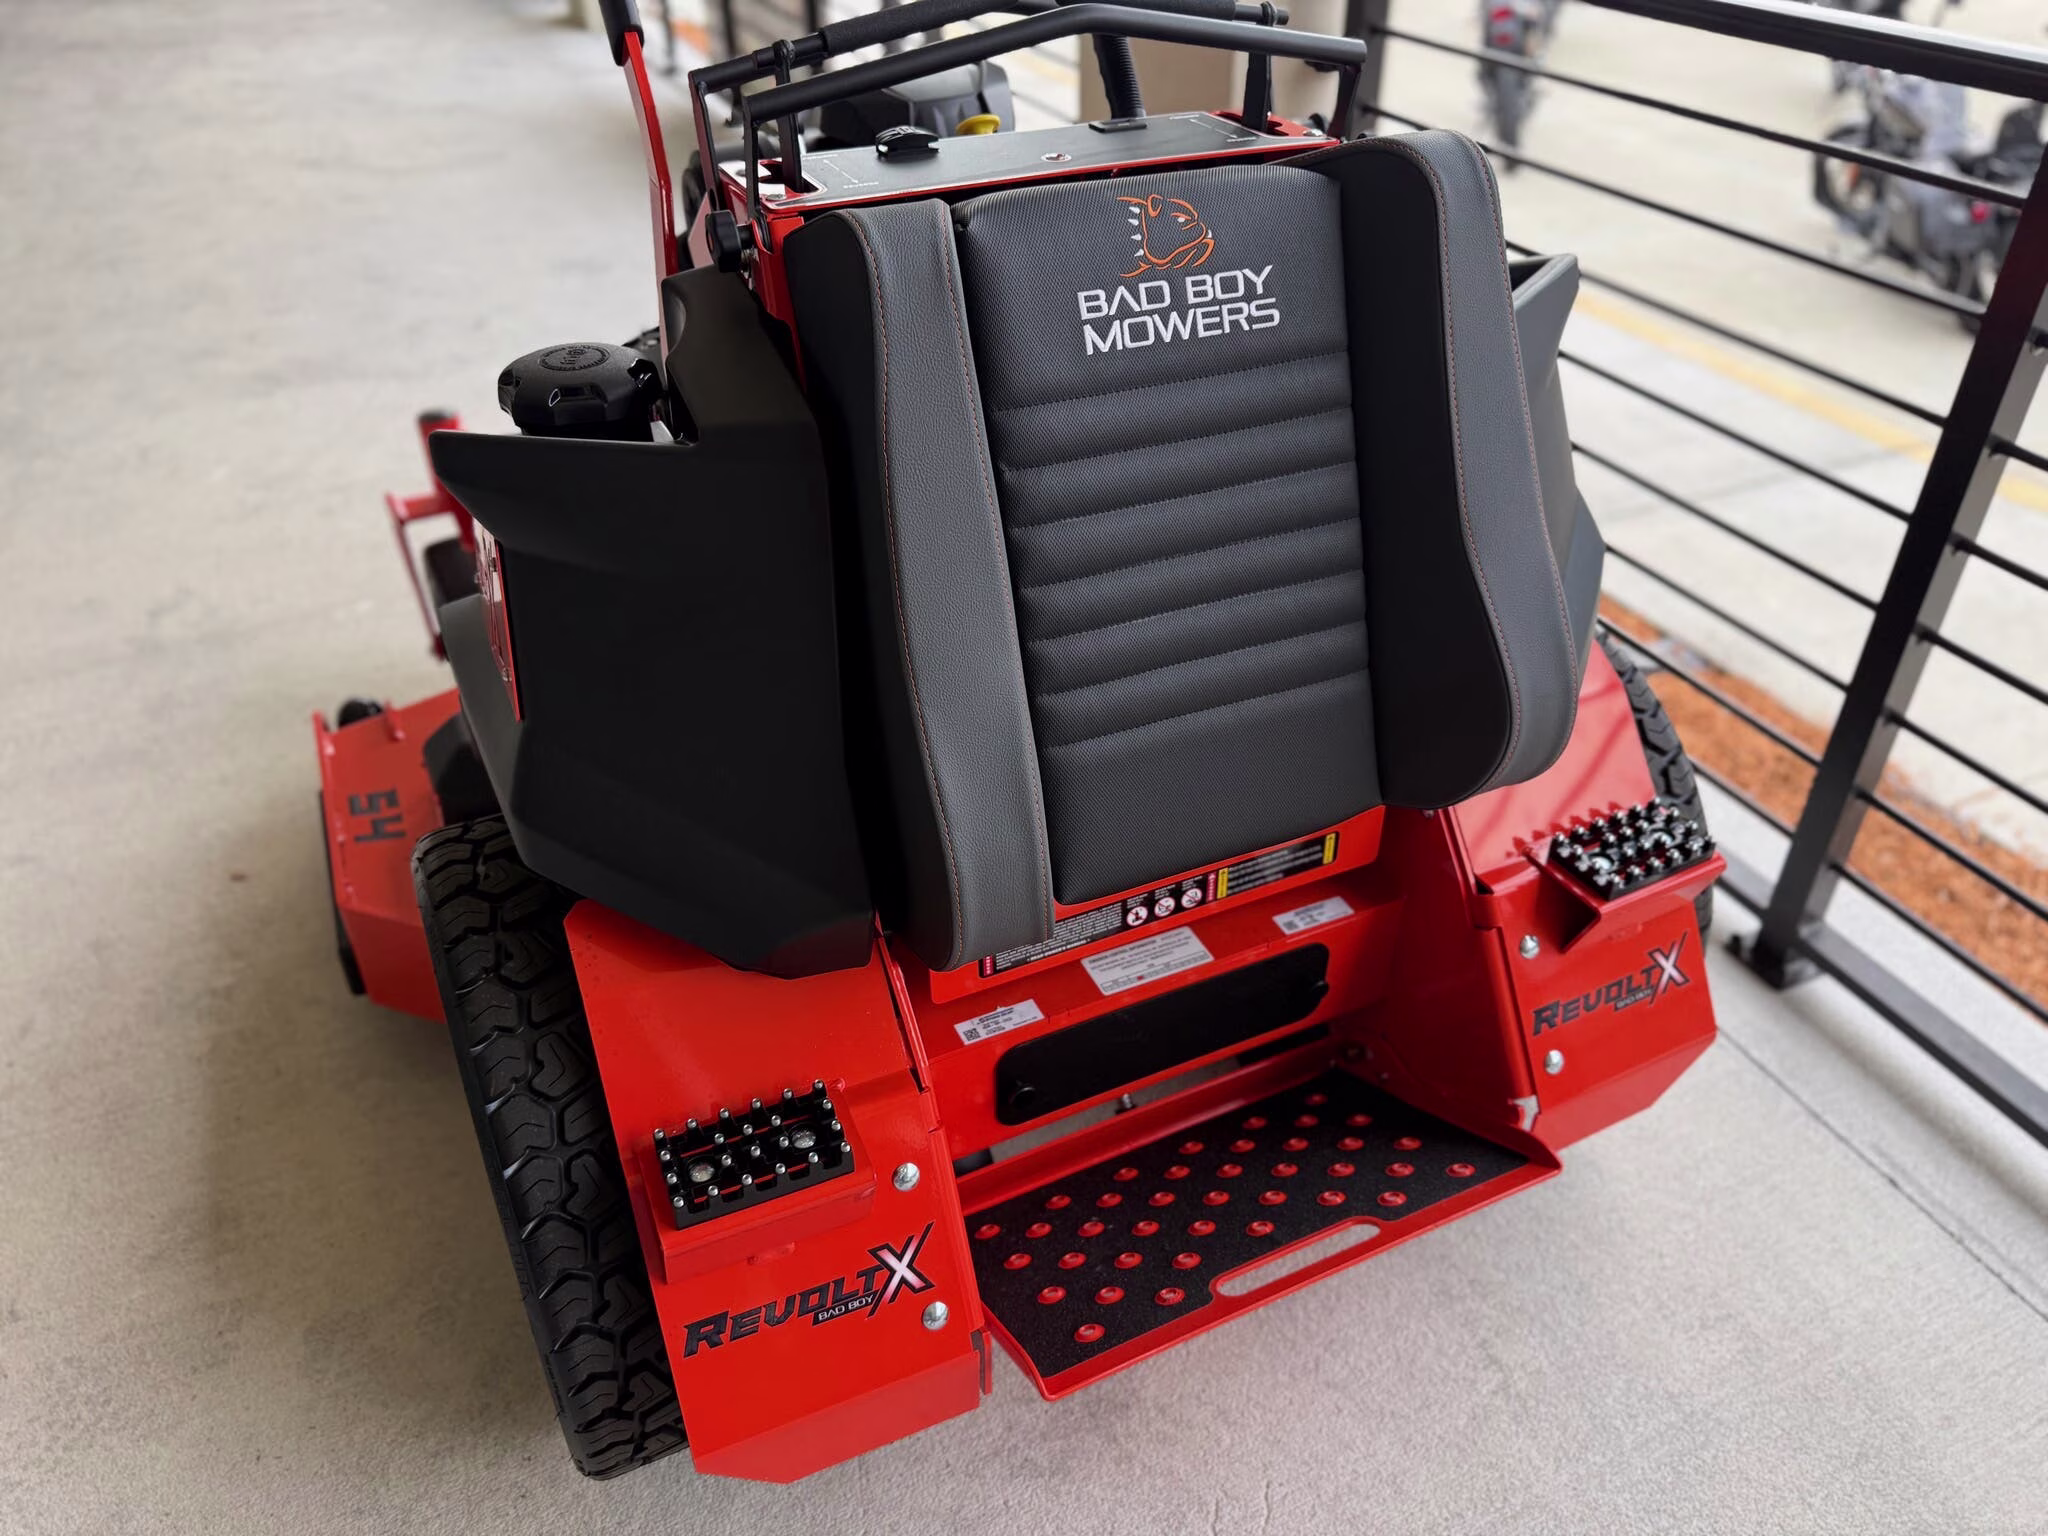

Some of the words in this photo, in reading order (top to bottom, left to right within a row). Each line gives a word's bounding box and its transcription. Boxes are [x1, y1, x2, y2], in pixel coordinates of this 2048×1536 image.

[1077, 280, 1171, 320] BAD
[1185, 265, 1273, 304] BOY
[1083, 297, 1280, 356] MOWERS
[348, 786, 406, 843] 54
[818, 1304, 846, 1321] BAD
[848, 1294, 874, 1310] BOY
